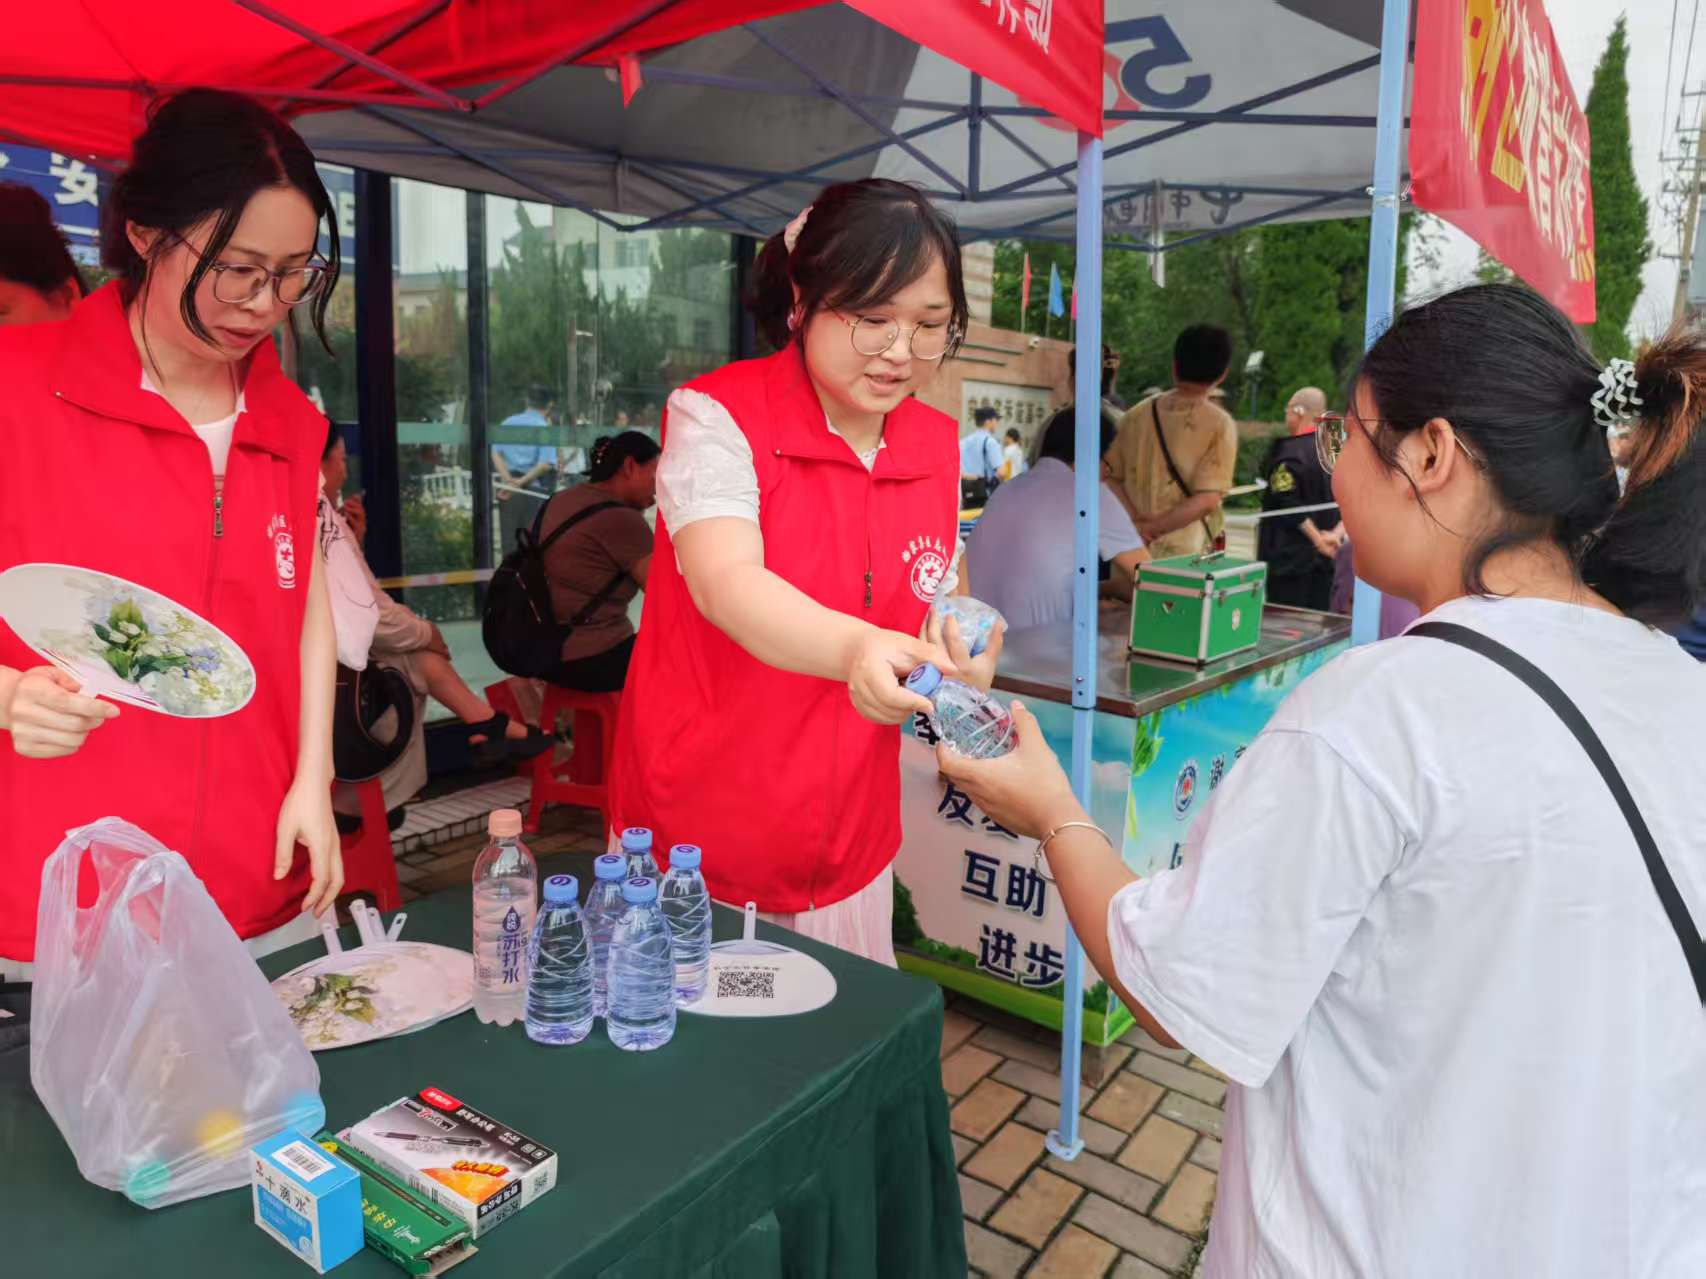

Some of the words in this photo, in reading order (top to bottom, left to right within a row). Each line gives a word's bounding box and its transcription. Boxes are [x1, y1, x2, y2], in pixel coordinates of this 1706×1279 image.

[960, 849, 1046, 918] 互助
[503, 933, 521, 984] 苏打水
[978, 923, 1065, 987] 进步
[264, 1175, 308, 1214] 十滴水
